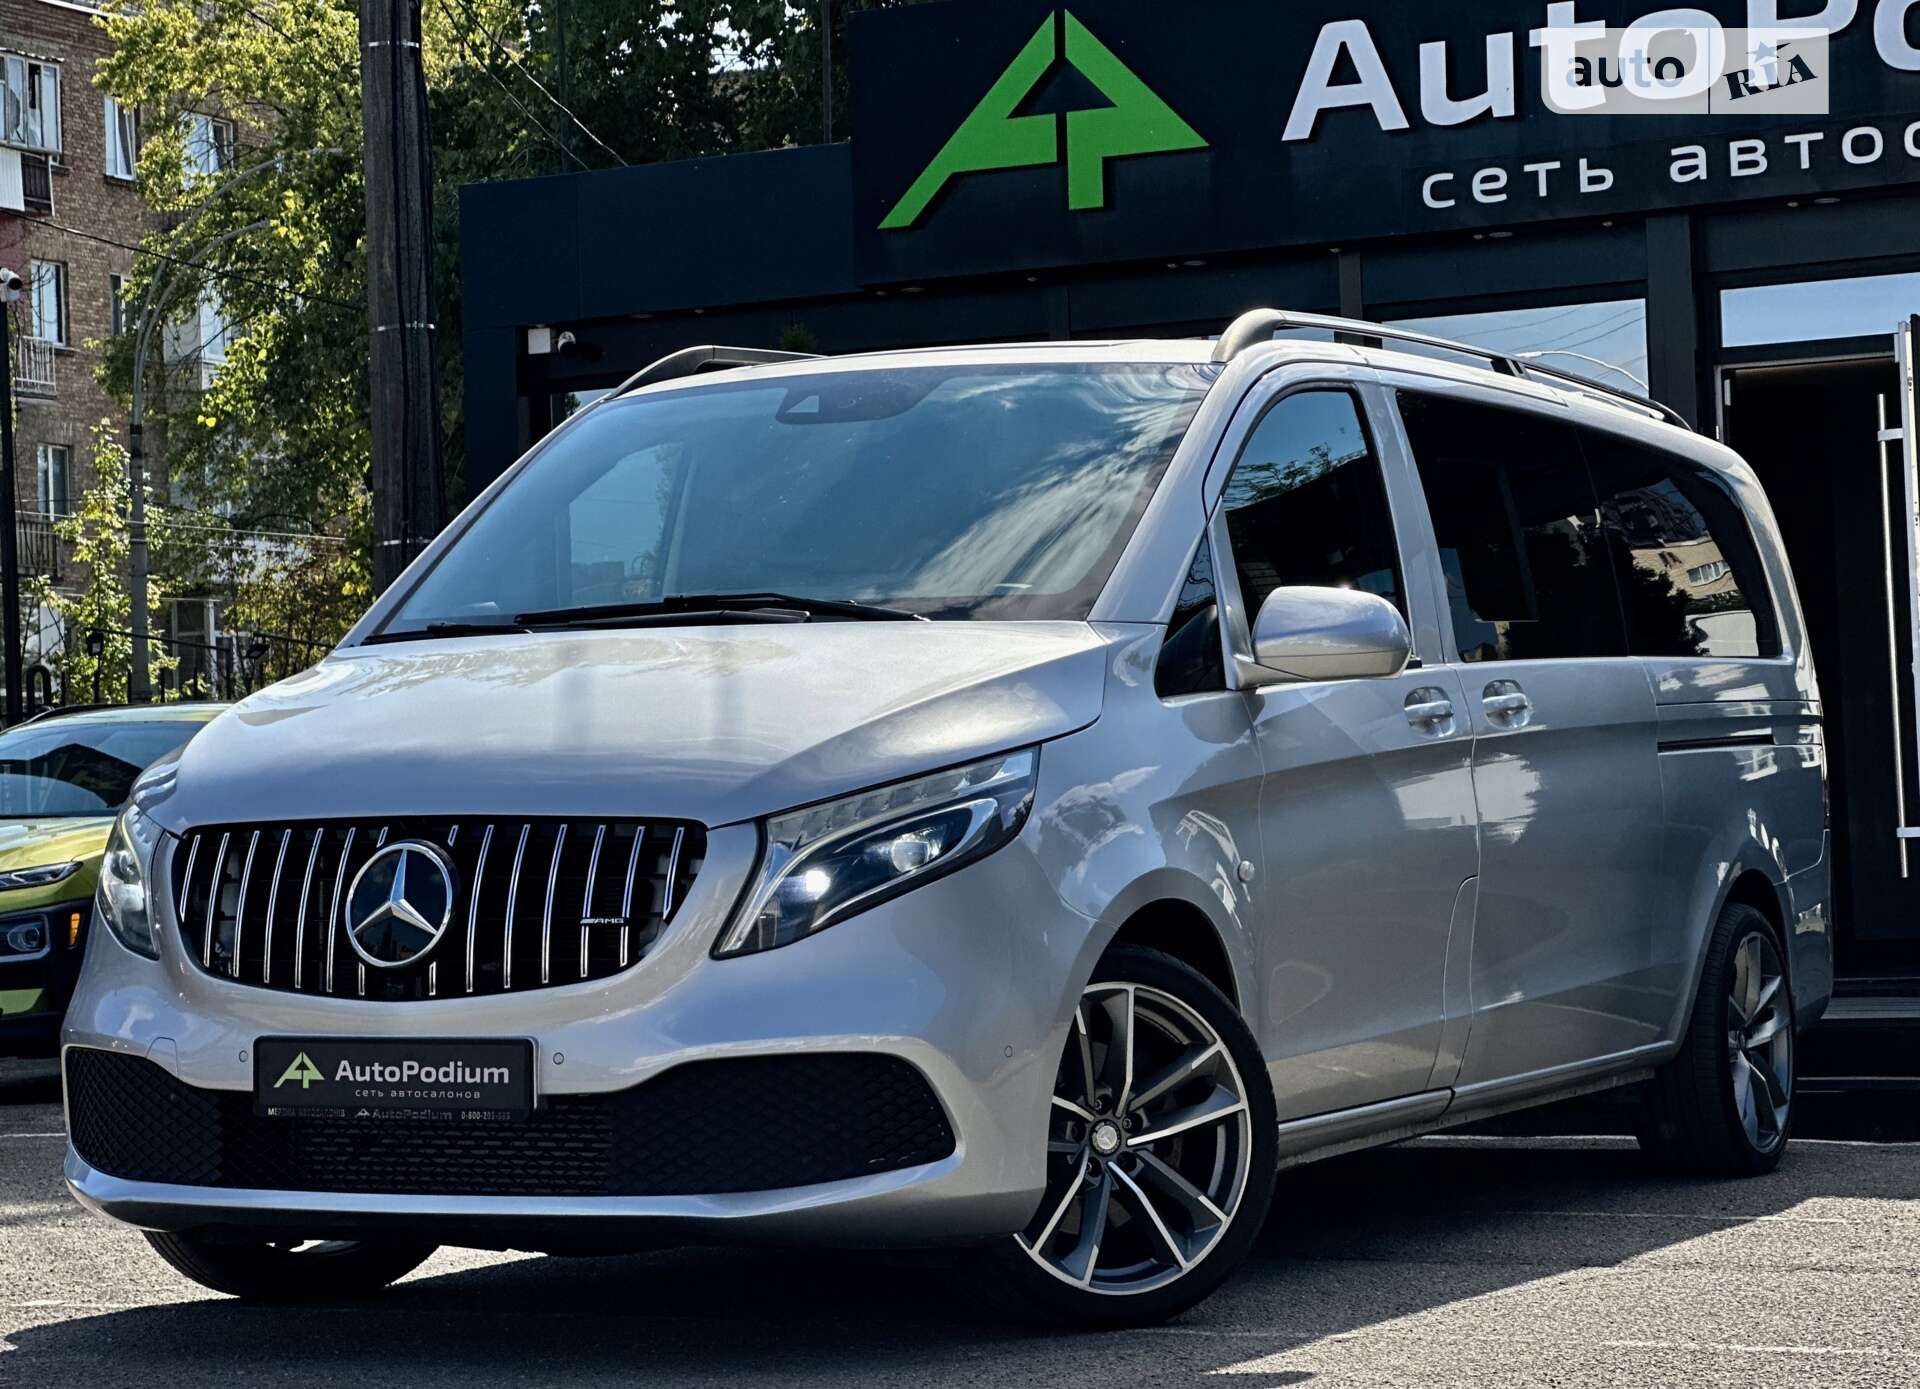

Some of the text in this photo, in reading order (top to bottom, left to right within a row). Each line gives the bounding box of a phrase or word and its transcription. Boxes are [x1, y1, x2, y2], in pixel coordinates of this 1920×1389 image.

[1422, 158, 1615, 209] сеть
[334, 1060, 510, 1084] AutoPodium
[355, 1089, 481, 1099] сеть автосалонов
